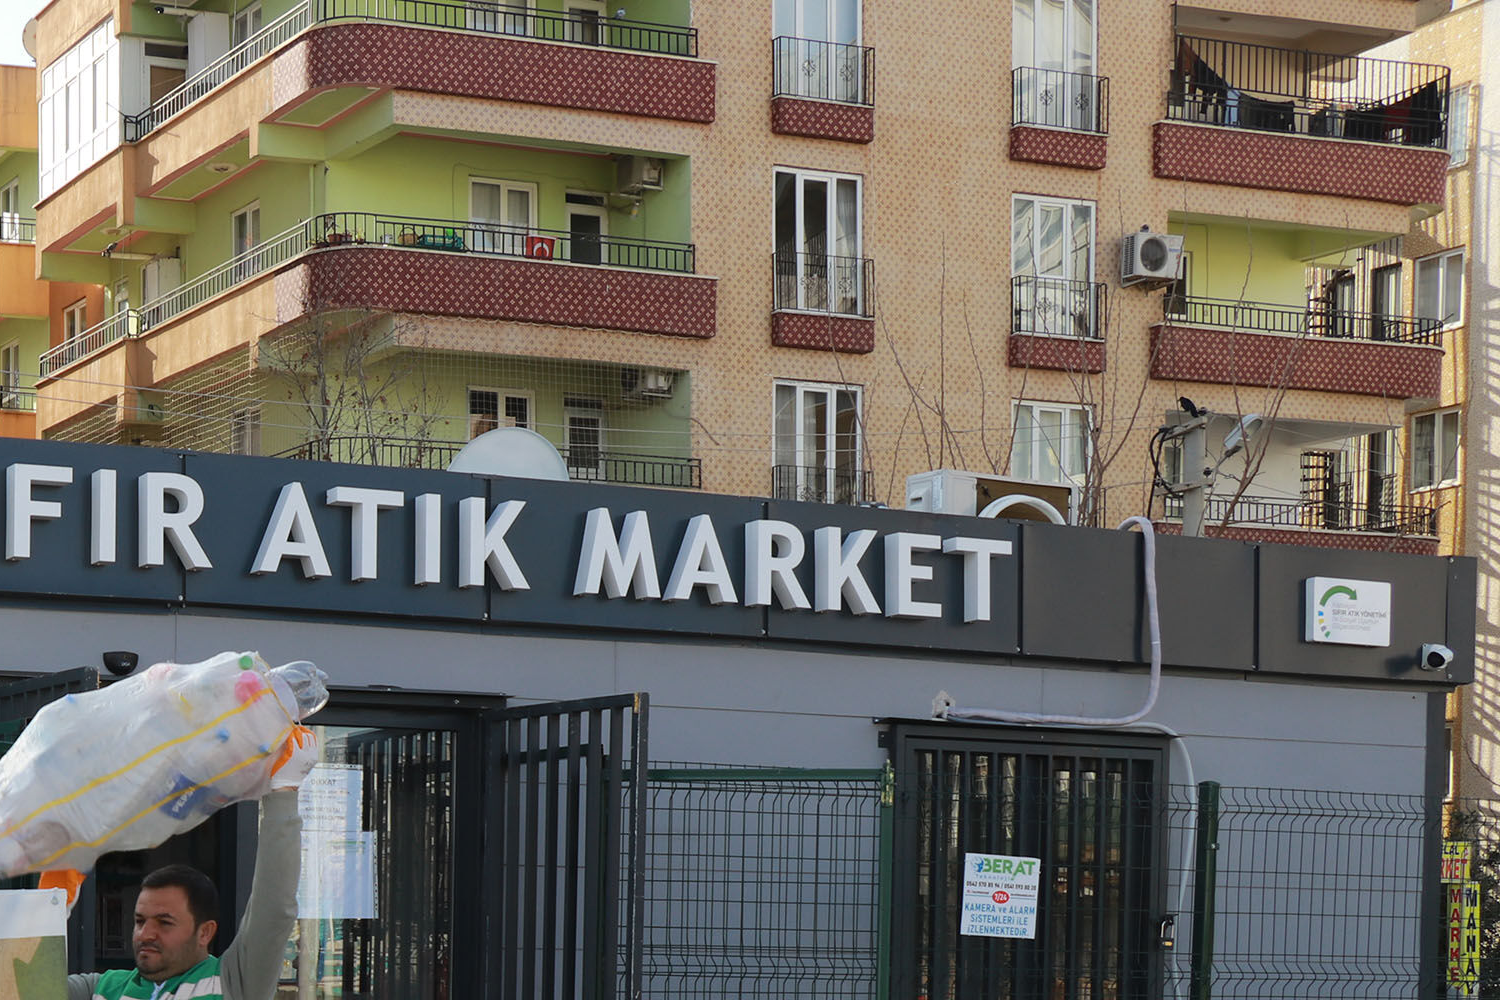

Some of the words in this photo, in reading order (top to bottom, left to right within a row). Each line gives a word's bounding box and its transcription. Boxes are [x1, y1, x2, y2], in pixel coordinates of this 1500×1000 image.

[249, 481, 531, 592] ATIK
[572, 506, 1013, 625] MARKET
[982, 857, 1037, 879] BERAT
[964, 902, 996, 913] KAMERA
[998, 906, 1007, 914] ve
[1008, 905, 1035, 916] ALARM
[1450, 888, 1462, 991] MARKE
